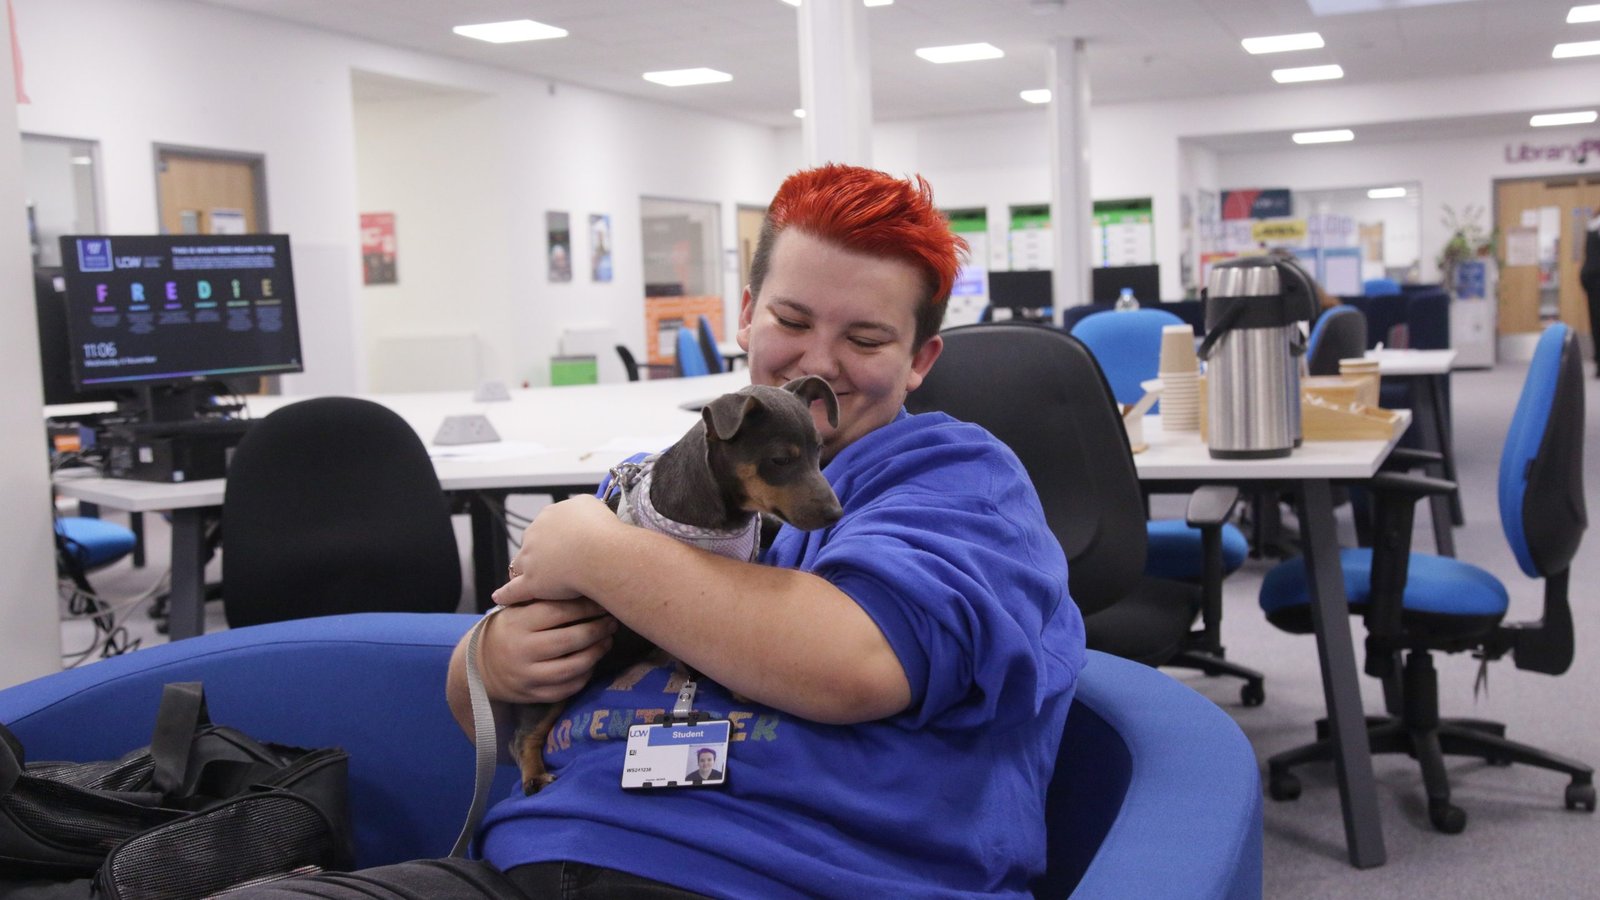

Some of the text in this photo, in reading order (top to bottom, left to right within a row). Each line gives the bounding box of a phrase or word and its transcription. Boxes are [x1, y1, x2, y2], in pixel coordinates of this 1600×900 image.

[114, 256, 142, 269] UCW
[96, 283, 109, 303] F
[131, 282, 145, 302] R
[165, 281, 178, 300] E
[197, 280, 212, 299] D
[261, 278, 273, 297] E
[84, 341, 117, 358] 11:06
[629, 730, 649, 738] UCW
[672, 730, 704, 739] Student
